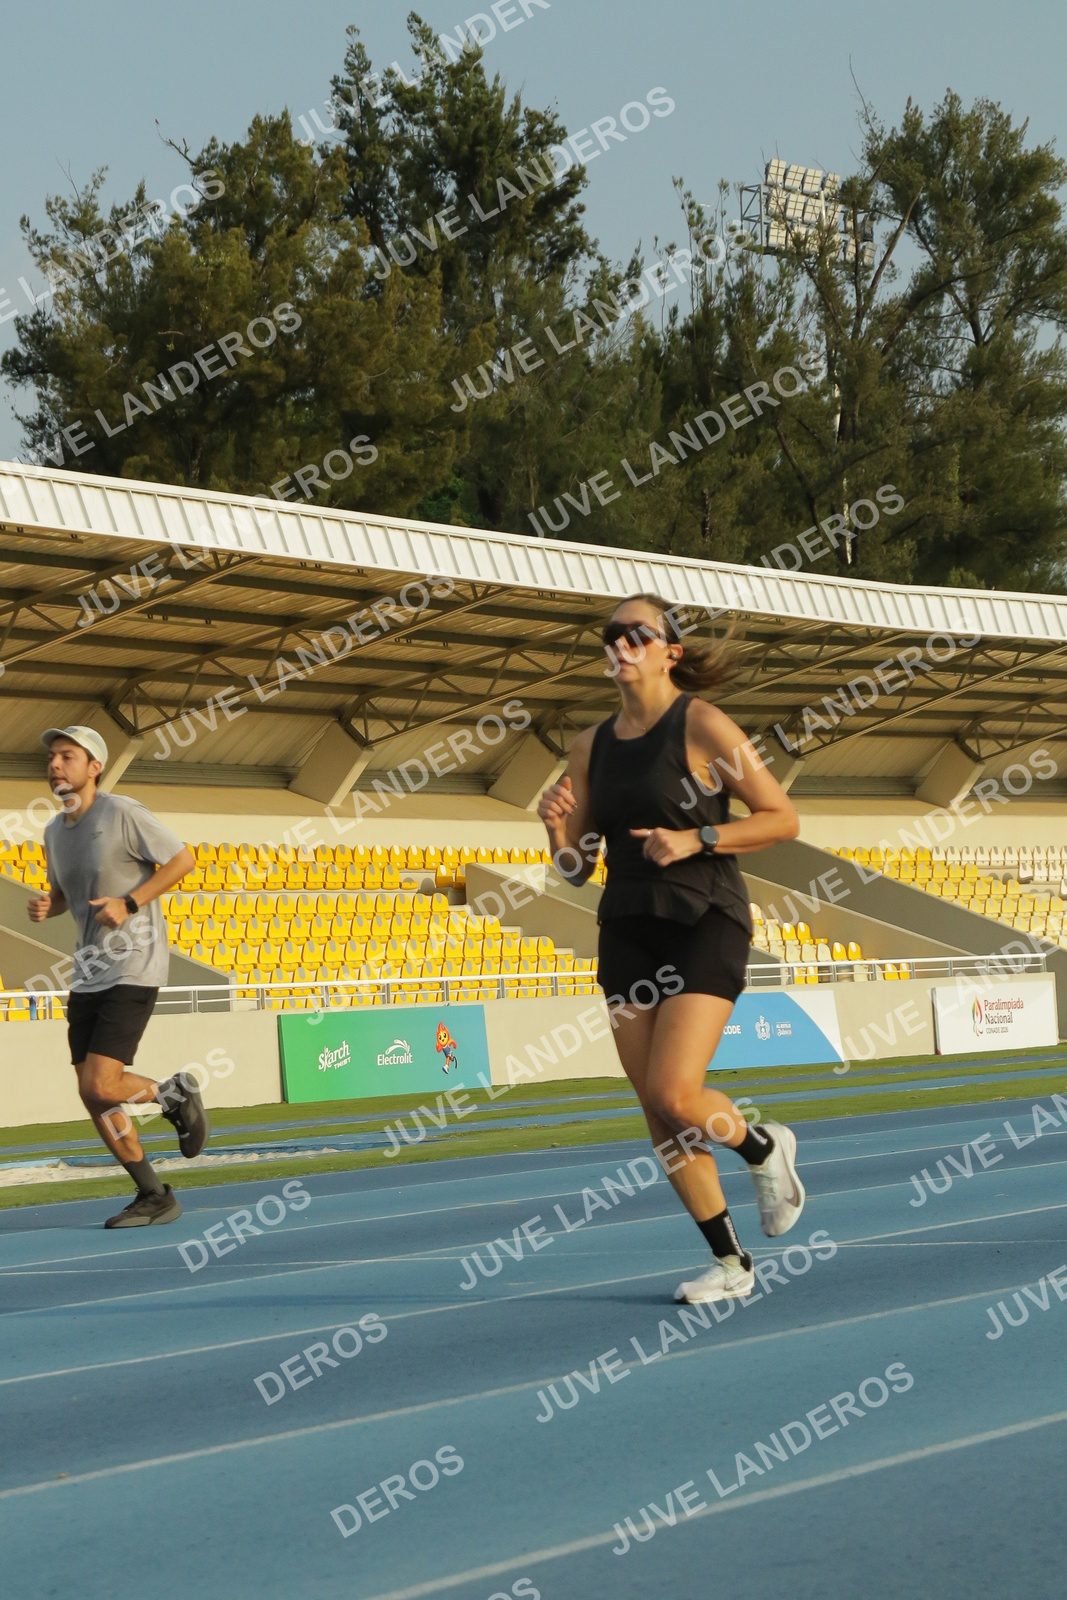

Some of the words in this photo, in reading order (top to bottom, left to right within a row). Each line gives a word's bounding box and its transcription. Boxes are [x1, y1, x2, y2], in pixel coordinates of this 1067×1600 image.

[984, 998, 1024, 1012] Paralimpiada
[985, 1012, 1013, 1024] Nacional
[723, 1025, 742, 1035] CODE
[377, 1053, 413, 1066] Electrolit
